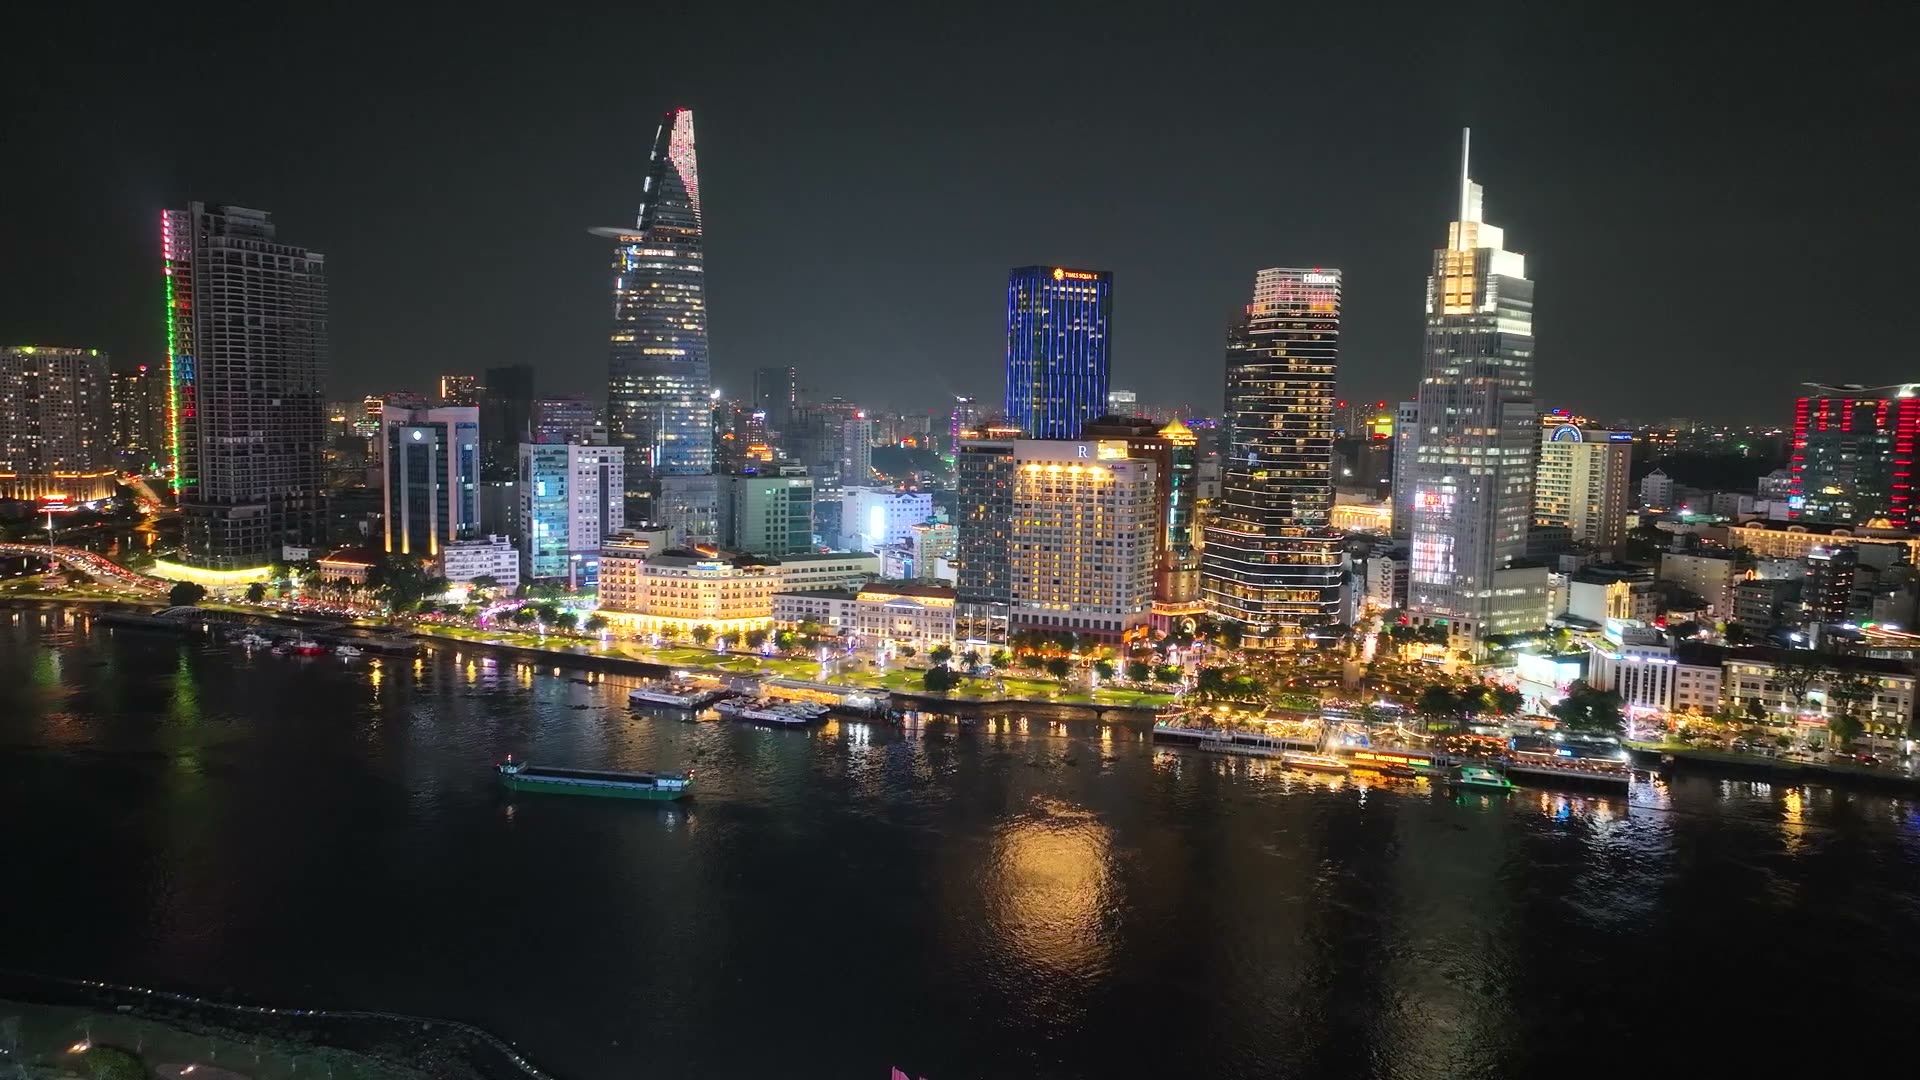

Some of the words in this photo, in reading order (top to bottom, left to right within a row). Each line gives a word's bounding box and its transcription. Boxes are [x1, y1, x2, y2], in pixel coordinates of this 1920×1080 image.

[1079, 272, 1098, 280] SQUAE
[1303, 273, 1336, 283] Hilton
[1077, 445, 1089, 458] R
